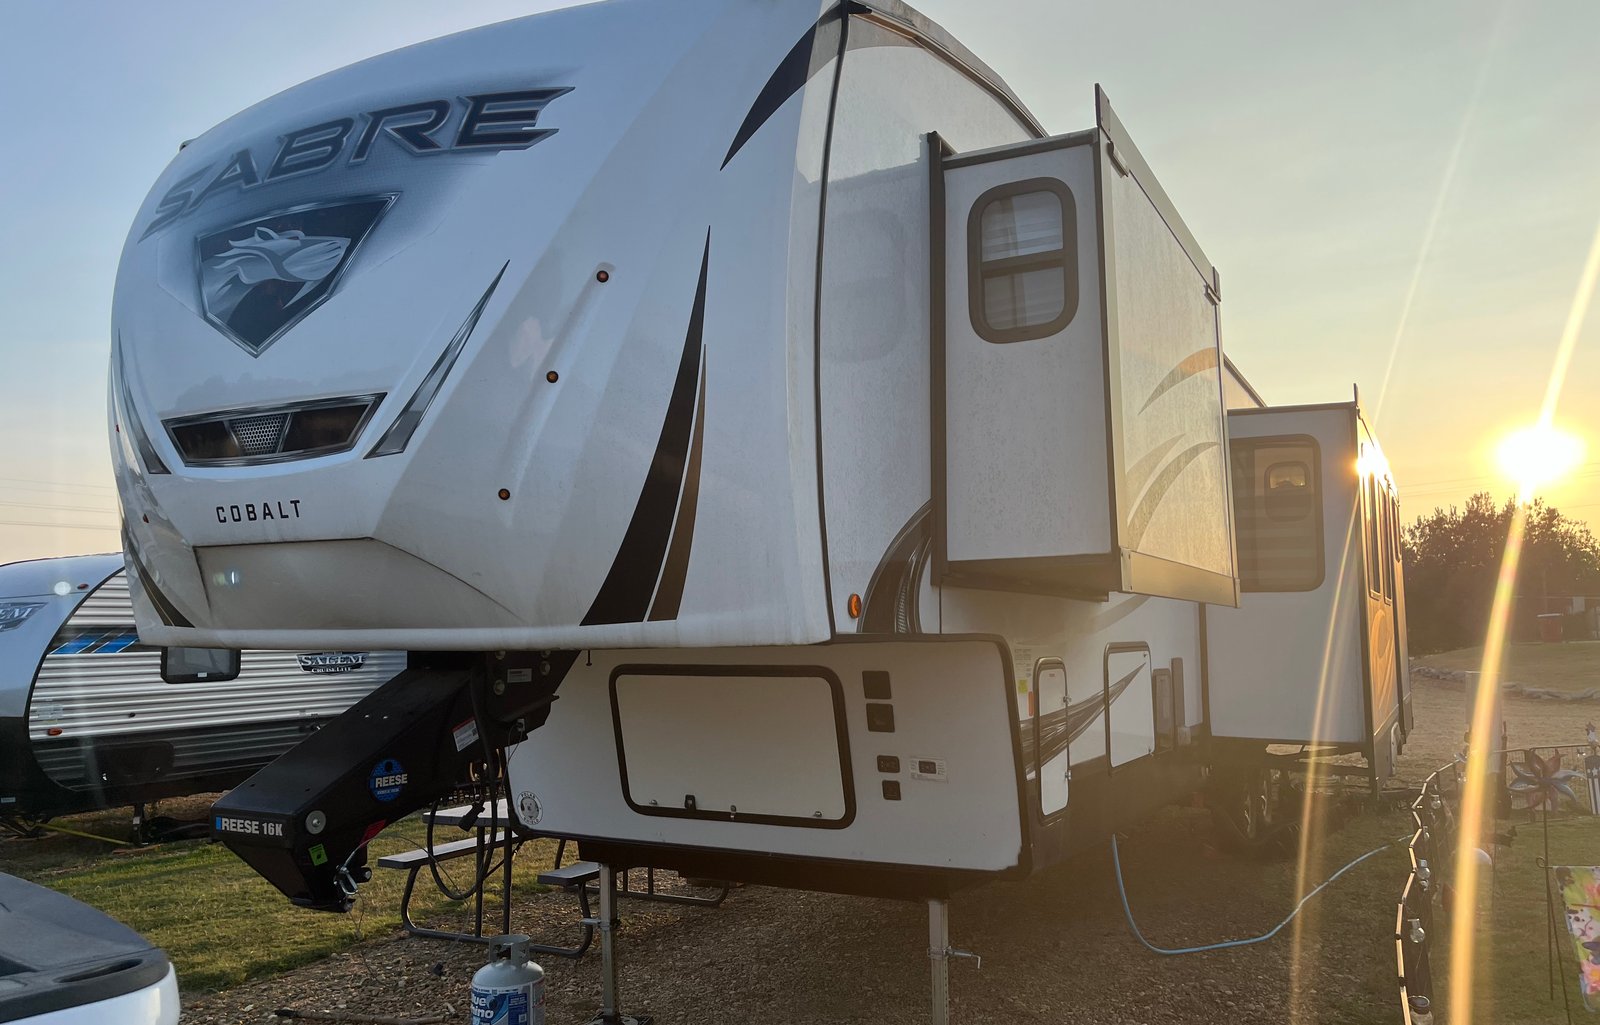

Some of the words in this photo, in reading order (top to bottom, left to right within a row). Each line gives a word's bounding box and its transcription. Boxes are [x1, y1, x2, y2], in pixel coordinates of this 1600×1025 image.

[138, 87, 575, 243] SABRE
[216, 500, 300, 523] COBALT
[301, 655, 363, 666] SALEM
[375, 774, 408, 788] REESE
[221, 817, 260, 834] REESE
[262, 822, 283, 836] 16K
